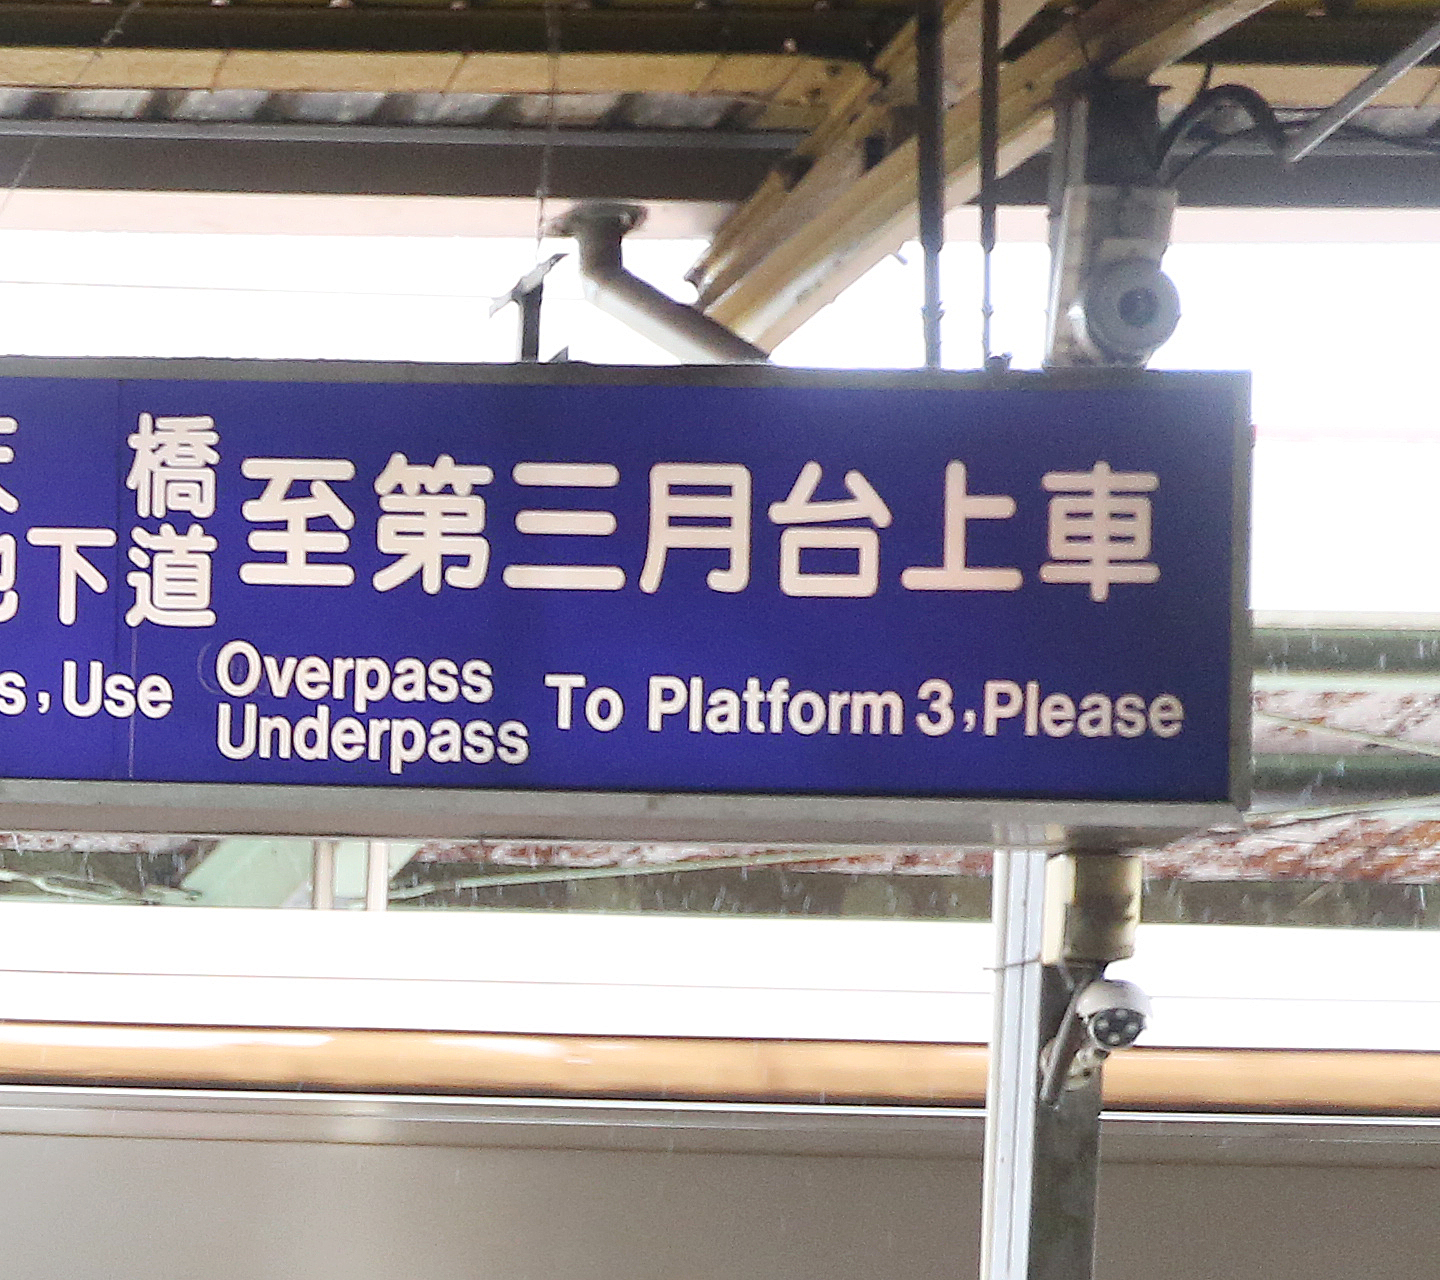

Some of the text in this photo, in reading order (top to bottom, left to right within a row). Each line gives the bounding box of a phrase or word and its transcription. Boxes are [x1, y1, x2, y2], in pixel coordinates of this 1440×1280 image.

[216, 639, 494, 714] Overpass
[544, 674, 625, 732] To
[648, 675, 904, 736] Platform
[217, 702, 530, 774] Underpass
